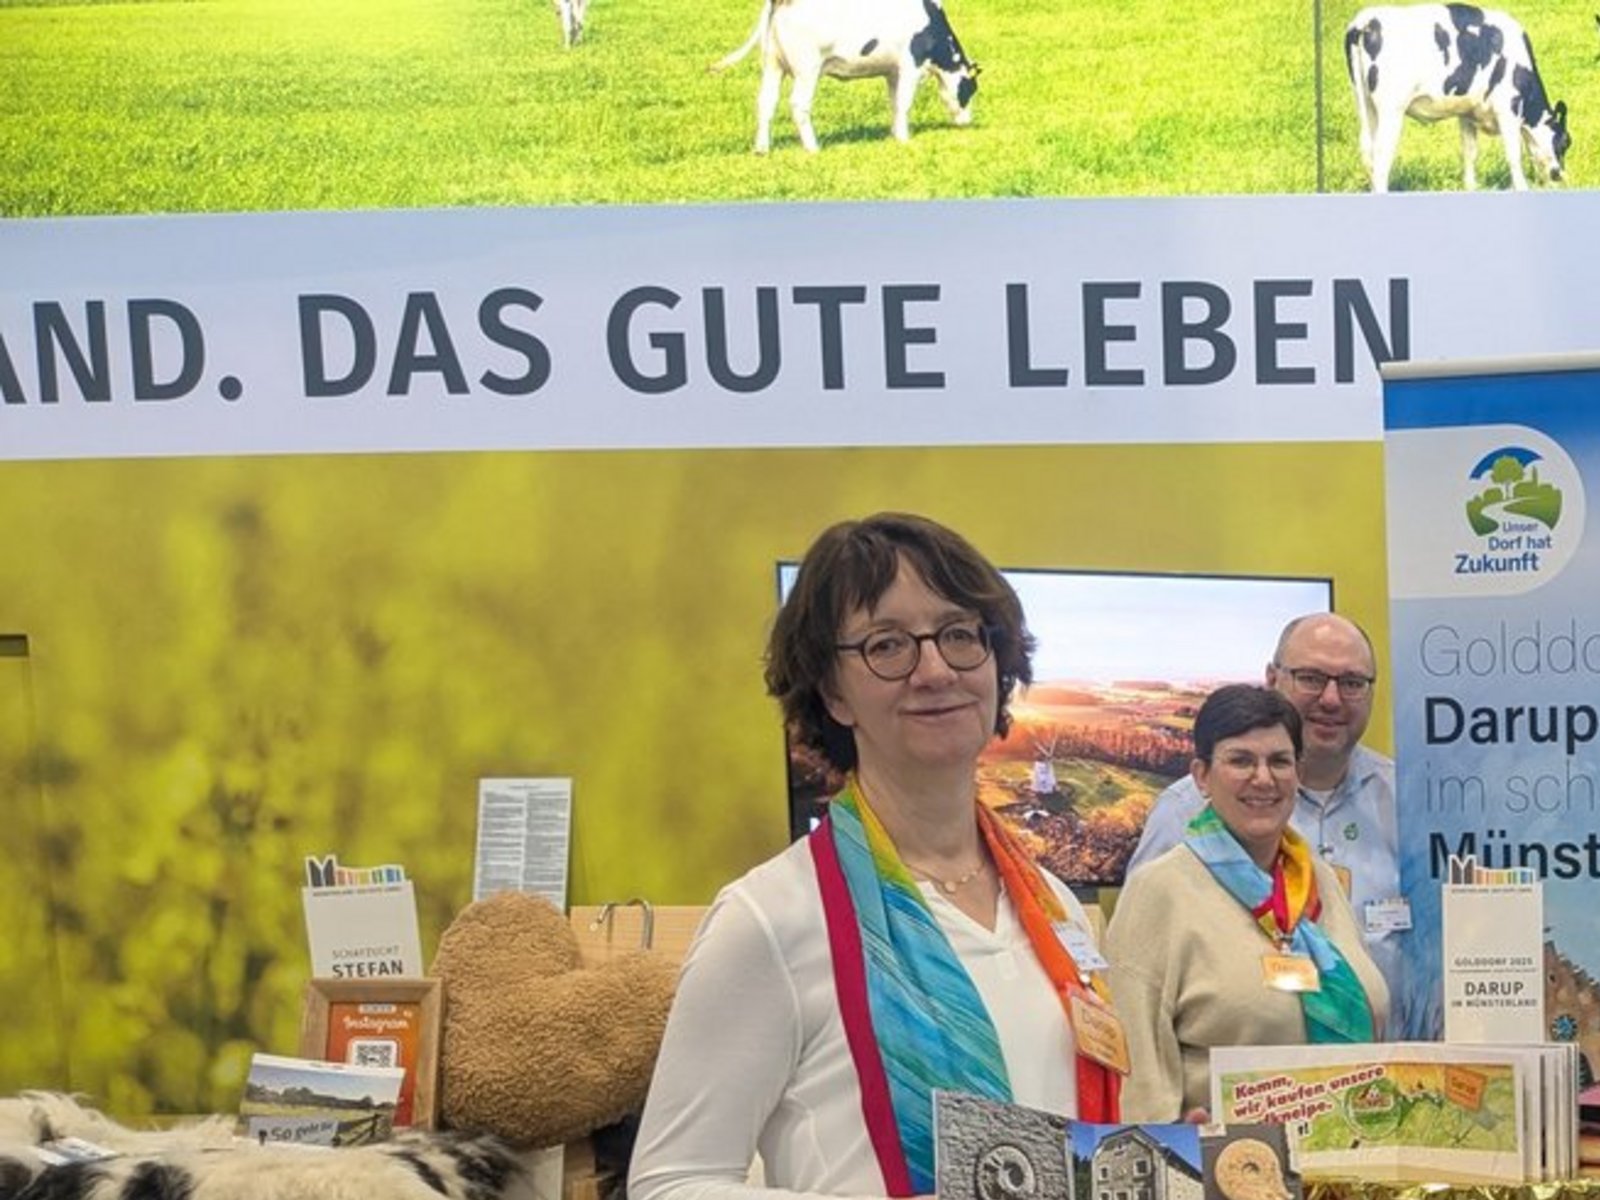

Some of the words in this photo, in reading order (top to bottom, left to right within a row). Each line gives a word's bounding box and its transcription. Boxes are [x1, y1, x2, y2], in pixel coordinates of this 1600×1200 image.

[298, 287, 552, 398] DAS
[606, 284, 946, 394] GUTE
[1006, 277, 1410, 387] LEBEN
[1503, 521, 1538, 533] Unser
[1488, 535, 1523, 551] Dorf
[1527, 534, 1553, 550] hat
[1454, 552, 1540, 574] Zukunft
[1425, 697, 1599, 755] Darup
[1426, 760, 1486, 814] im
[332, 960, 404, 979] STEFAN
[1464, 981, 1524, 996] DARUP
[1234, 1075, 1293, 1100] Komm,
[1264, 1083, 1325, 1112] kaufen
[1329, 1065, 1385, 1091] unsere
